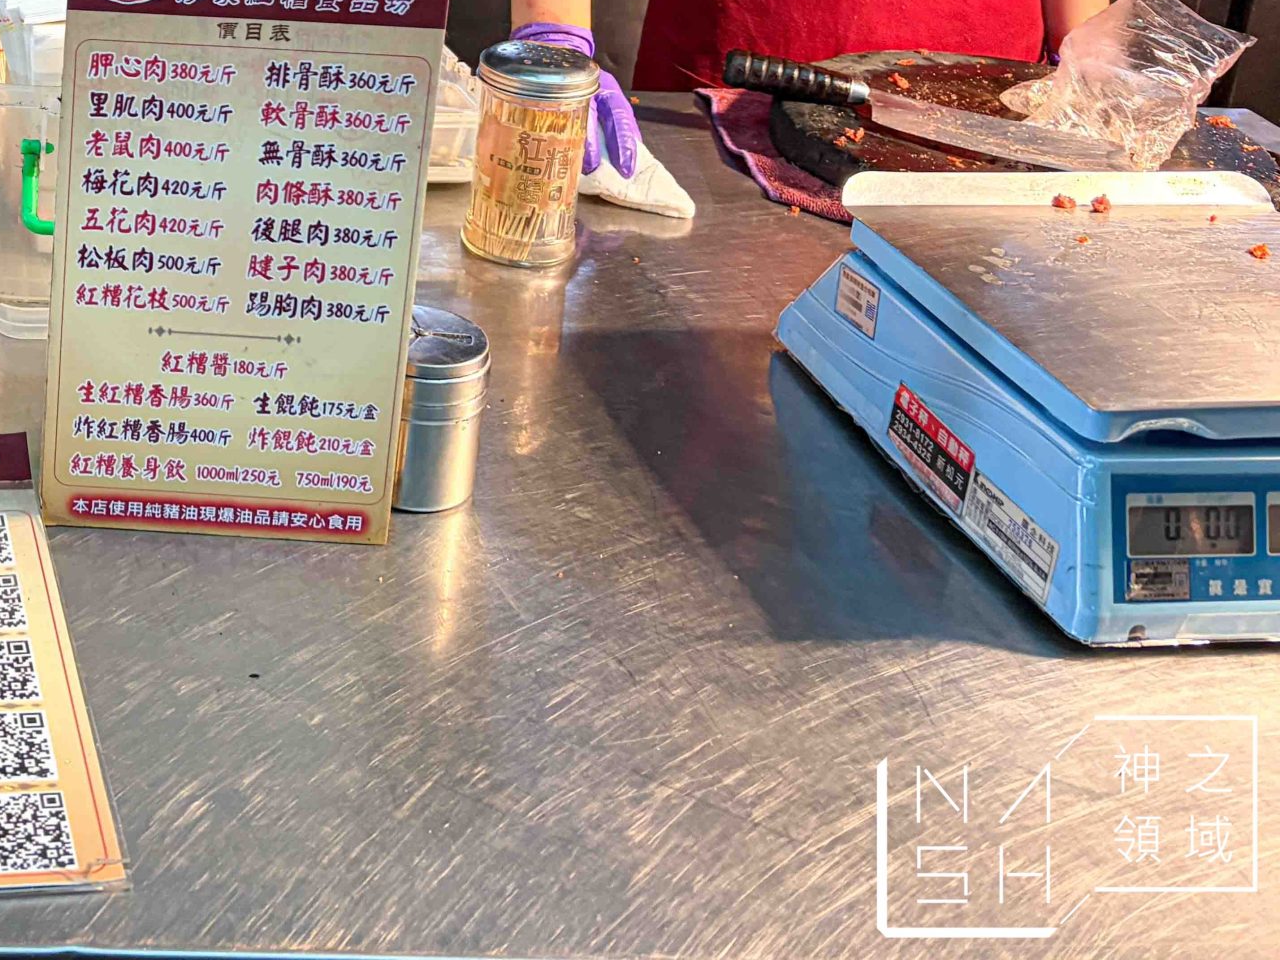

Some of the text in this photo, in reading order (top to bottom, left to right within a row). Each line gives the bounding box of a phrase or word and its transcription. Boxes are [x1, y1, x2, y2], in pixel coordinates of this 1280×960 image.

[217, 21, 291, 42] 價目表
[264, 61, 417, 97] 排骨酥360元/斤
[89, 91, 234, 124] 里肌肉400元/斤
[260, 101, 412, 136] 軟骨酥360元/斤
[85, 130, 230, 162] 老鼠肉400元/斤
[258, 140, 408, 173] 無骨酥360元/斤
[82, 169, 227, 201] 梅花肉420元/斤
[255, 178, 403, 212] 肉條酥380元/斤
[80, 207, 225, 239] 五花肉420元/斤
[251, 216, 399, 250] 後腿肉380元/斤
[77, 243, 222, 276] 松板肉500元/斤
[75, 283, 230, 315] 紅糟花枝500元/斤
[160, 350, 288, 380] 紅糟醬180元/斤
[70, 453, 187, 482] 紅糟養身飲
